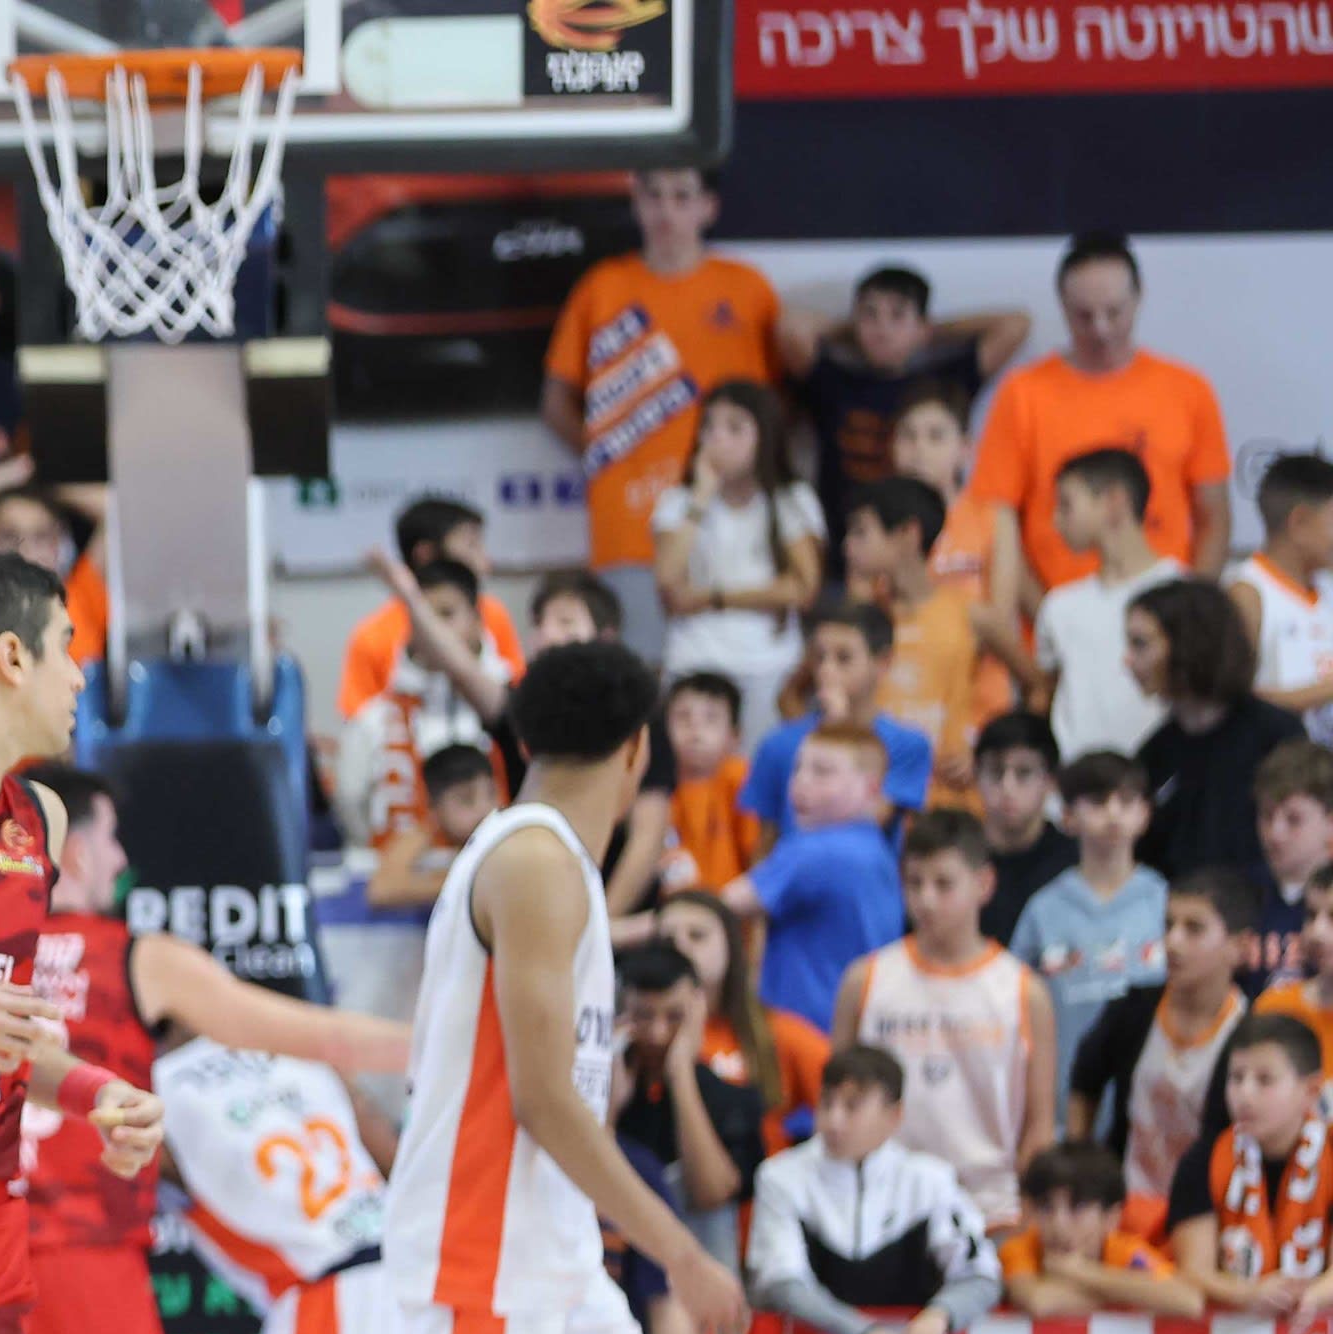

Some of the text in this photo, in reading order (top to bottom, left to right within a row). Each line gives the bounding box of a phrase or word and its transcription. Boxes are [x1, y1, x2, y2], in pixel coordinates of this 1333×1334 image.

[757, 9, 926, 66] צריכה
[937, 0, 1059, 78] שלך
[126, 884, 309, 945] REDIT
